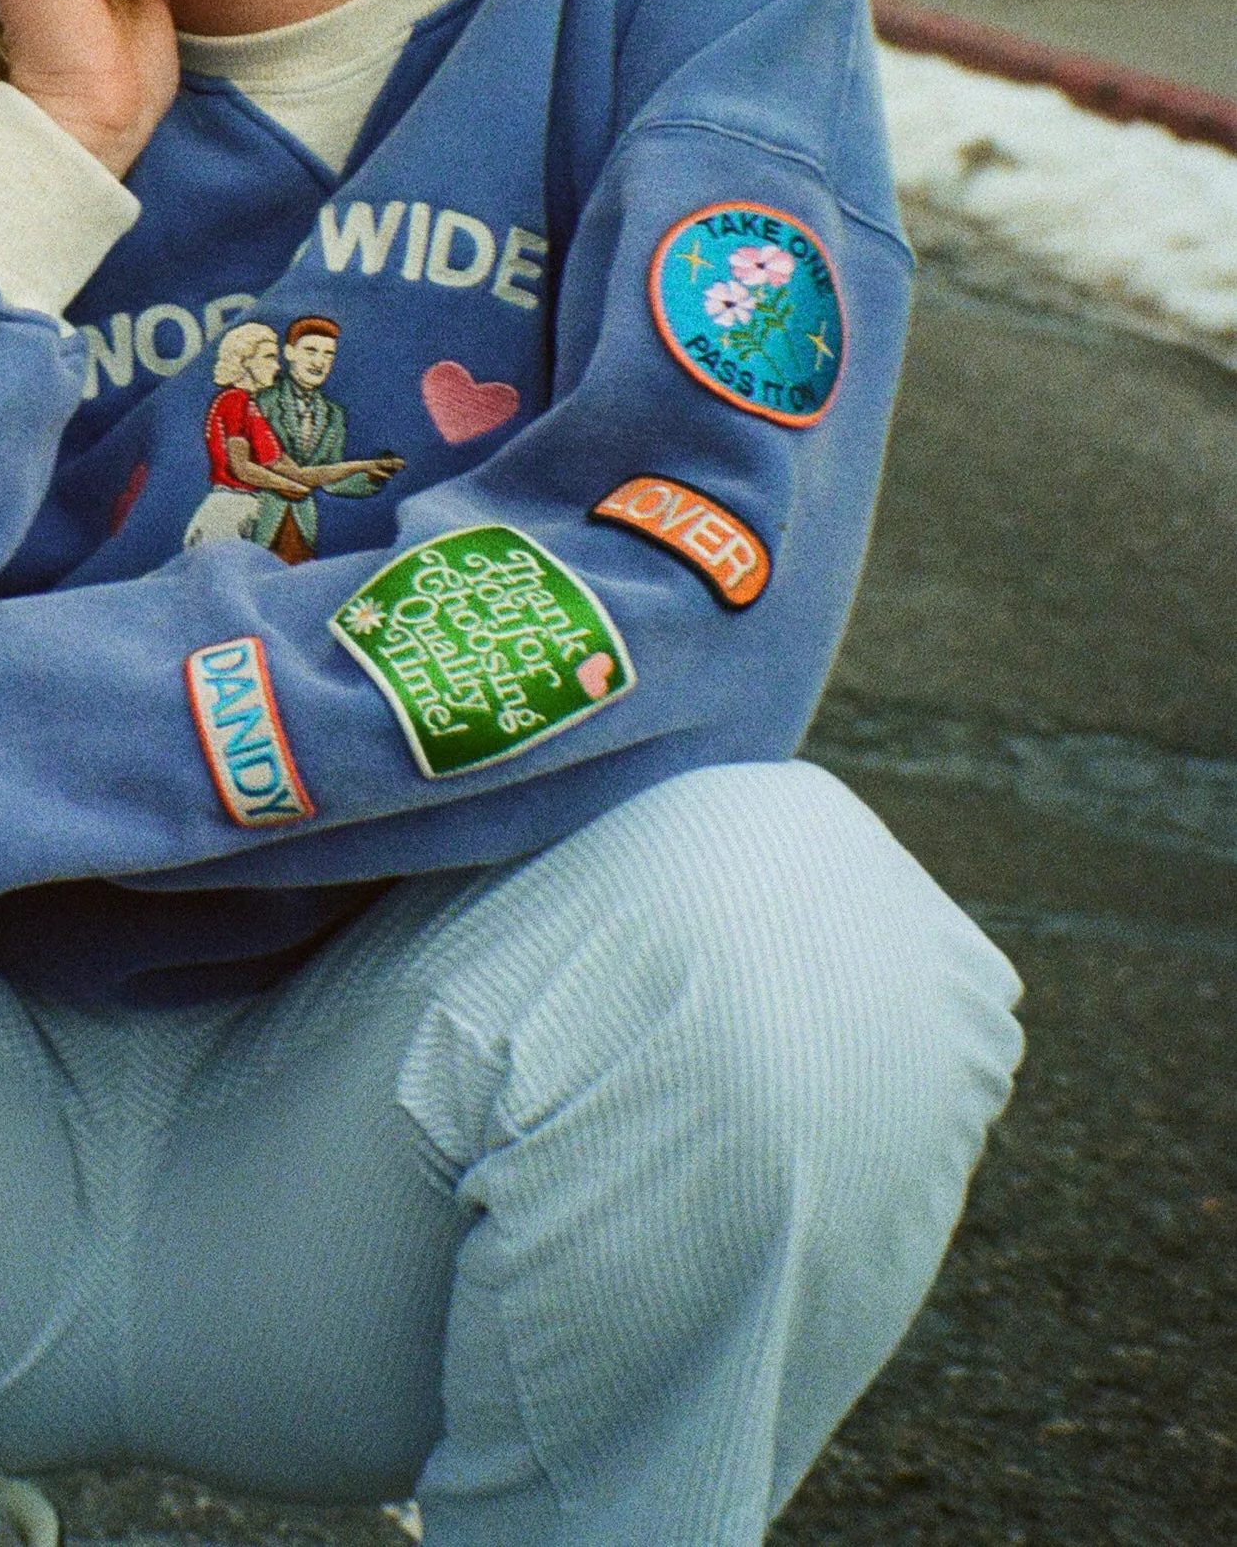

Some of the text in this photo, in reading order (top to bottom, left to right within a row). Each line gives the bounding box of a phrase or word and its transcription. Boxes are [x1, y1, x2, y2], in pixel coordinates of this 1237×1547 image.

[695, 212, 783, 246] TAKE
[685, 334, 755, 398] PASS
[764, 380, 784, 406] IT
[602, 482, 759, 591] LOVER
[389, 595, 492, 714] Quality
[414, 549, 547, 734] Choosing
[465, 553, 562, 689] You for
[497, 549, 593, 662] Thank
[201, 645, 302, 817] DANDY
